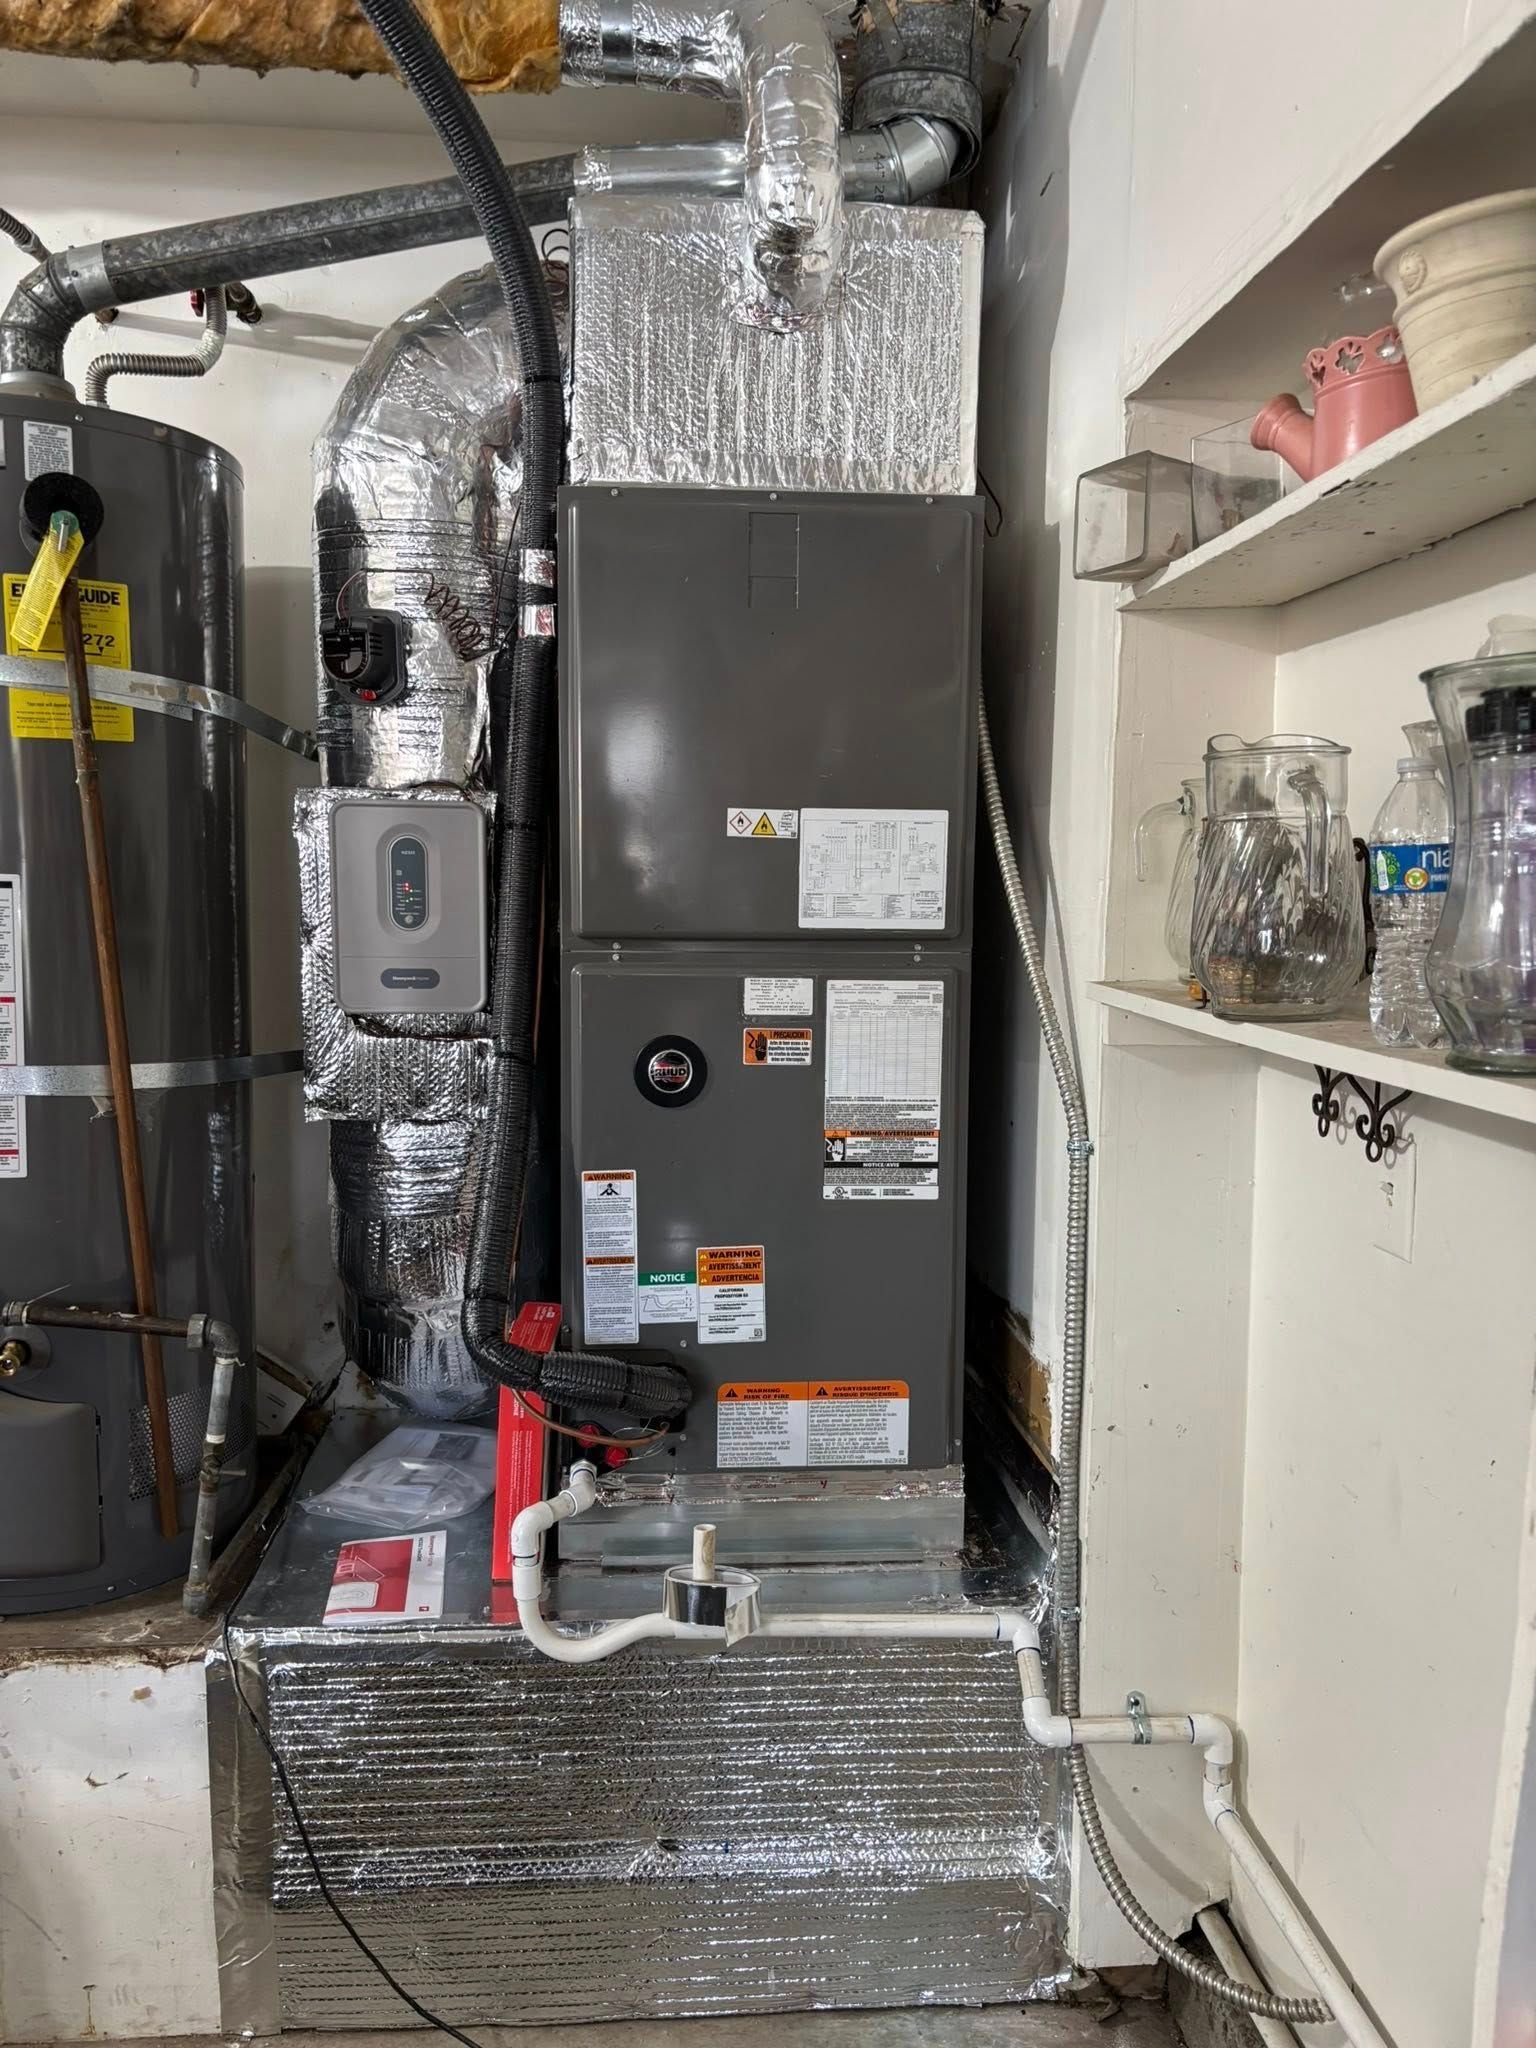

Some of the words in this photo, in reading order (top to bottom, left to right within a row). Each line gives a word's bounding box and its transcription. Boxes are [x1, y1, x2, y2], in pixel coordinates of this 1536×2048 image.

[593, 1173, 631, 1181] WARNING
[708, 1250, 761, 1259] WARNING
[708, 1261, 762, 1271] AVERTISSEMENT
[650, 1273, 686, 1283] NOTICE
[711, 1273, 760, 1283] ADVERTENCIA
